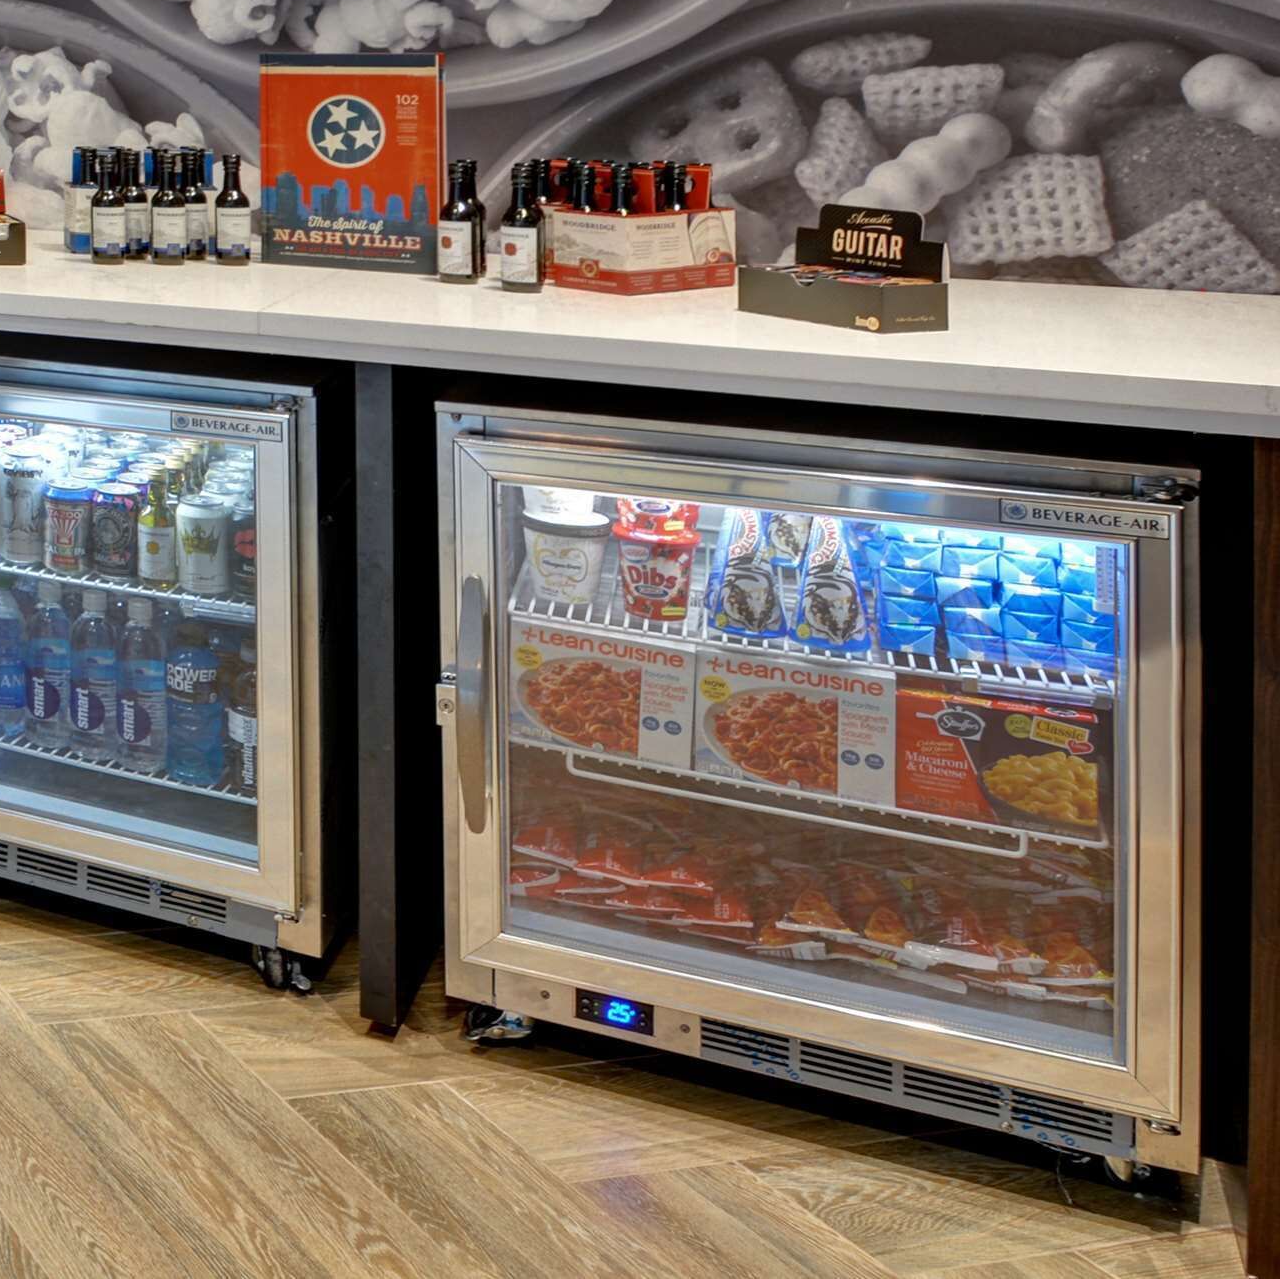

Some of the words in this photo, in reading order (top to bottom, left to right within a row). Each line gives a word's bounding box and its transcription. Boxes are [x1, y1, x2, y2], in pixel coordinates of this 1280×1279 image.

[396, 95, 419, 105] 102
[308, 215, 330, 228] The
[332, 216, 368, 231] Spirit
[368, 219, 384, 235] of
[562, 219, 617, 232] WOODBRIDGE
[636, 222, 676, 232] WOODBRIDGE
[847, 211, 894, 225] Acoustic
[273, 228, 421, 250] NASHVILLE
[832, 228, 904, 261] GUITAR
[627, 566, 677, 589] Dibs
[166, 663, 217, 682] POWER
[33, 677, 45, 718] smart
[77, 687, 89, 730] smart
[123, 698, 135, 741] smart
[1037, 721, 1086, 740] Classic
[905, 751, 969, 770] Macaroni
[919, 764, 967, 779] Cheese
